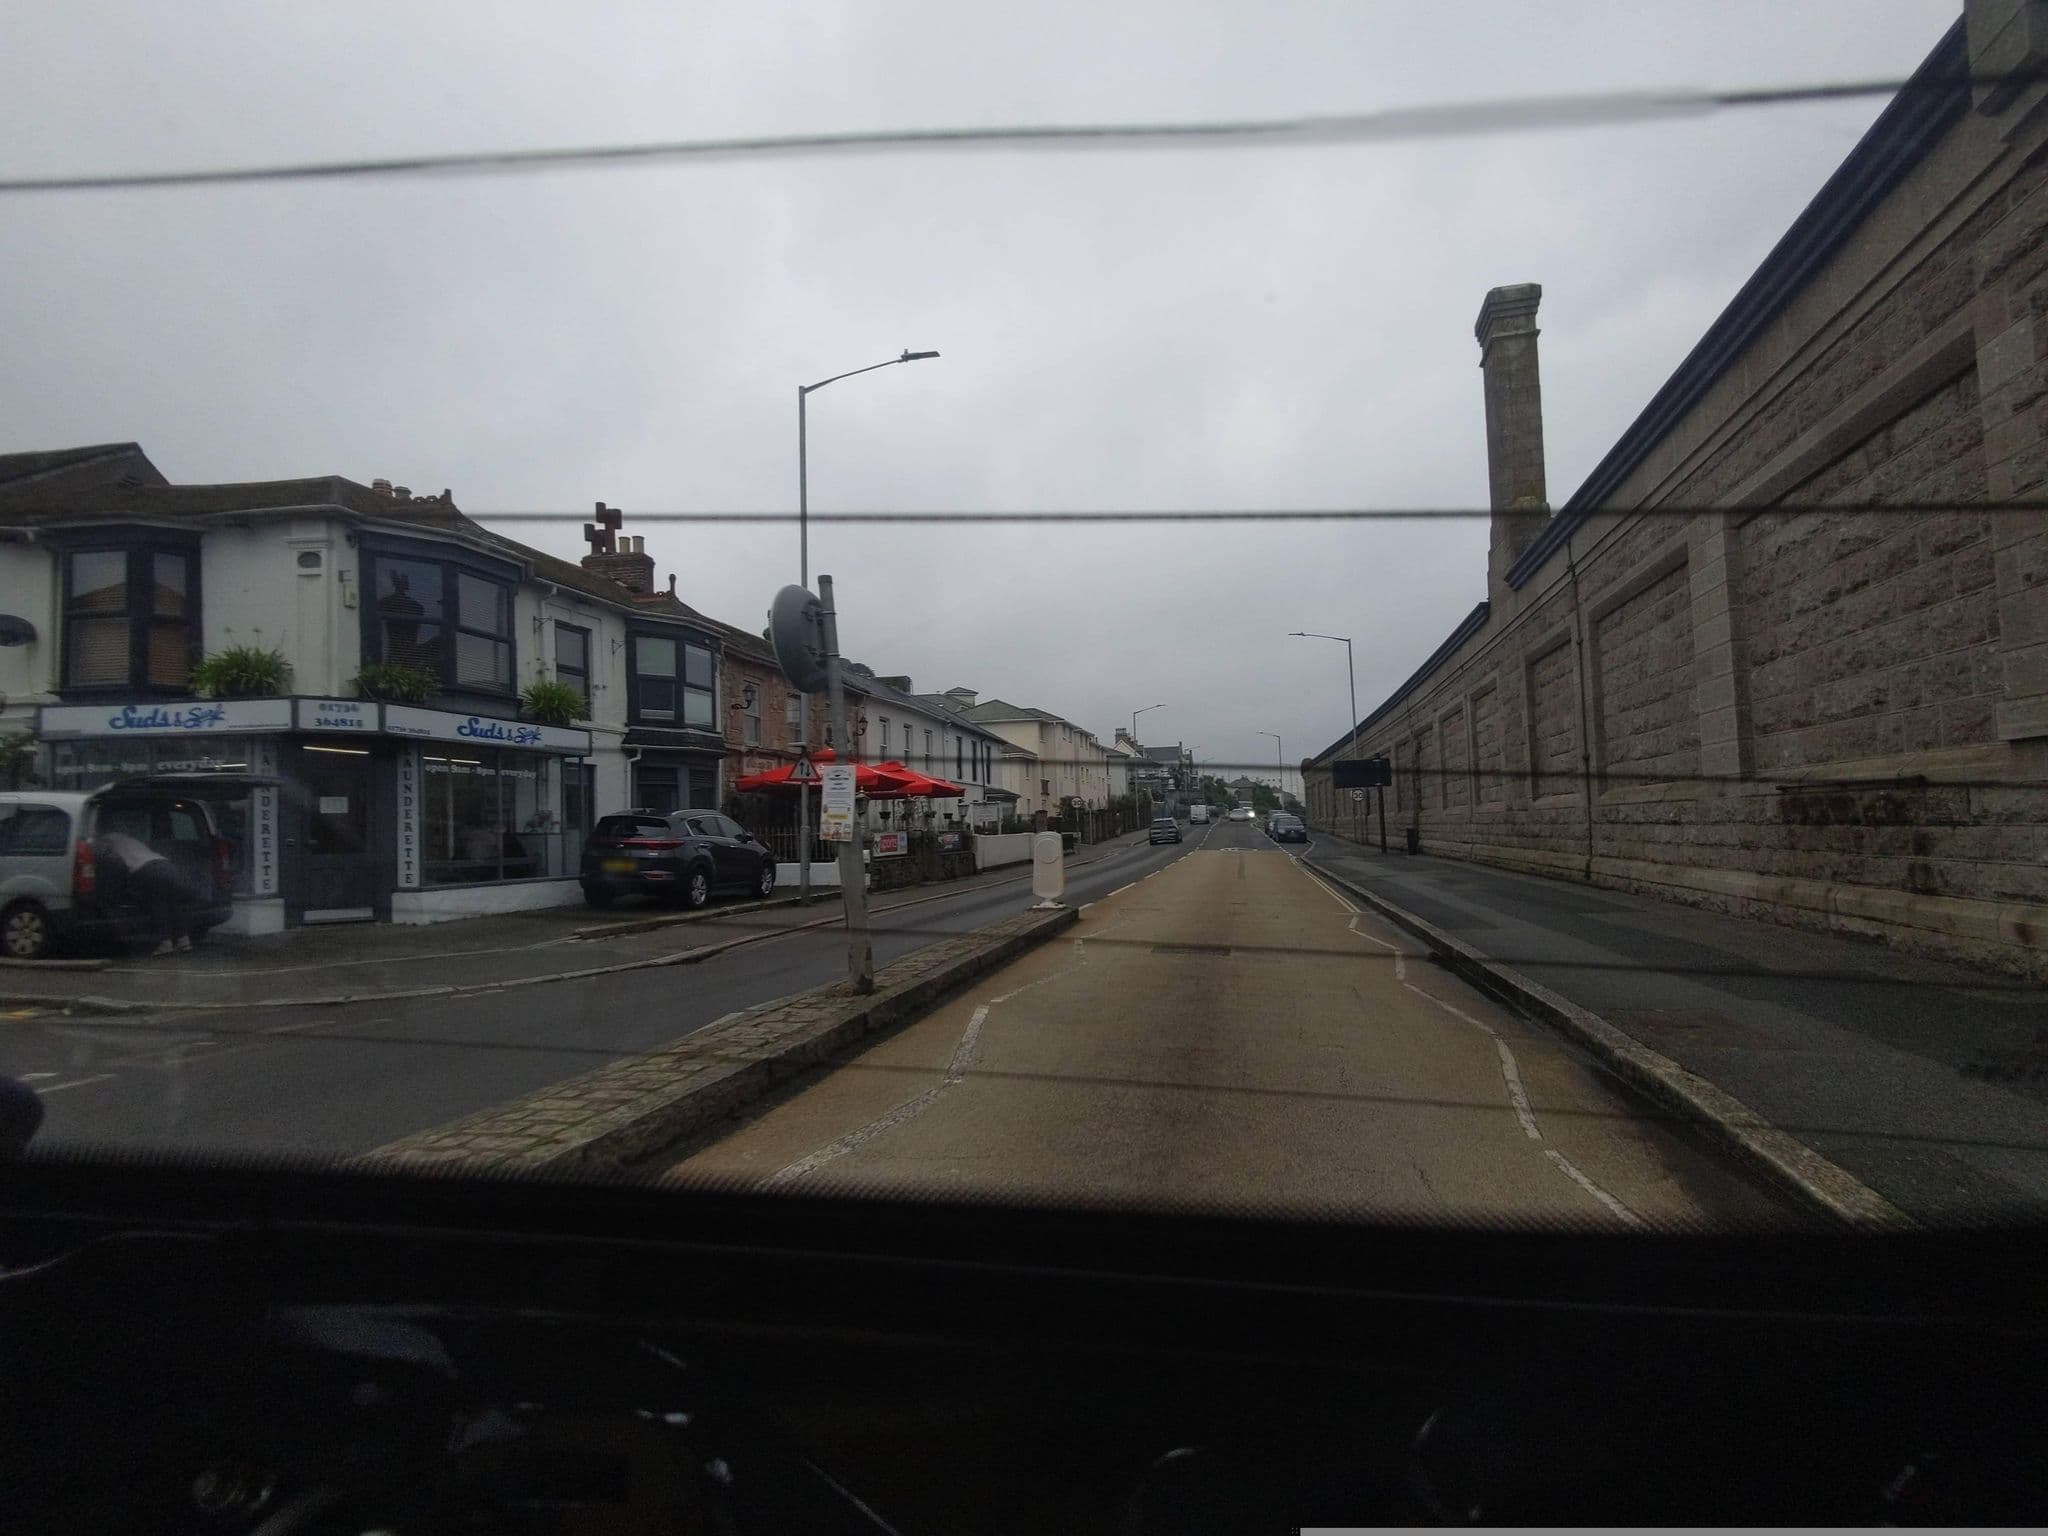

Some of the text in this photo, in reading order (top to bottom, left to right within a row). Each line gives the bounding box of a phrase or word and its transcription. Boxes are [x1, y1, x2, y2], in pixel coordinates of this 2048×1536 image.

[108, 705, 171, 729] Suds
[456, 717, 506, 740] Suds
[261, 742, 272, 890] AUNDERETTE
